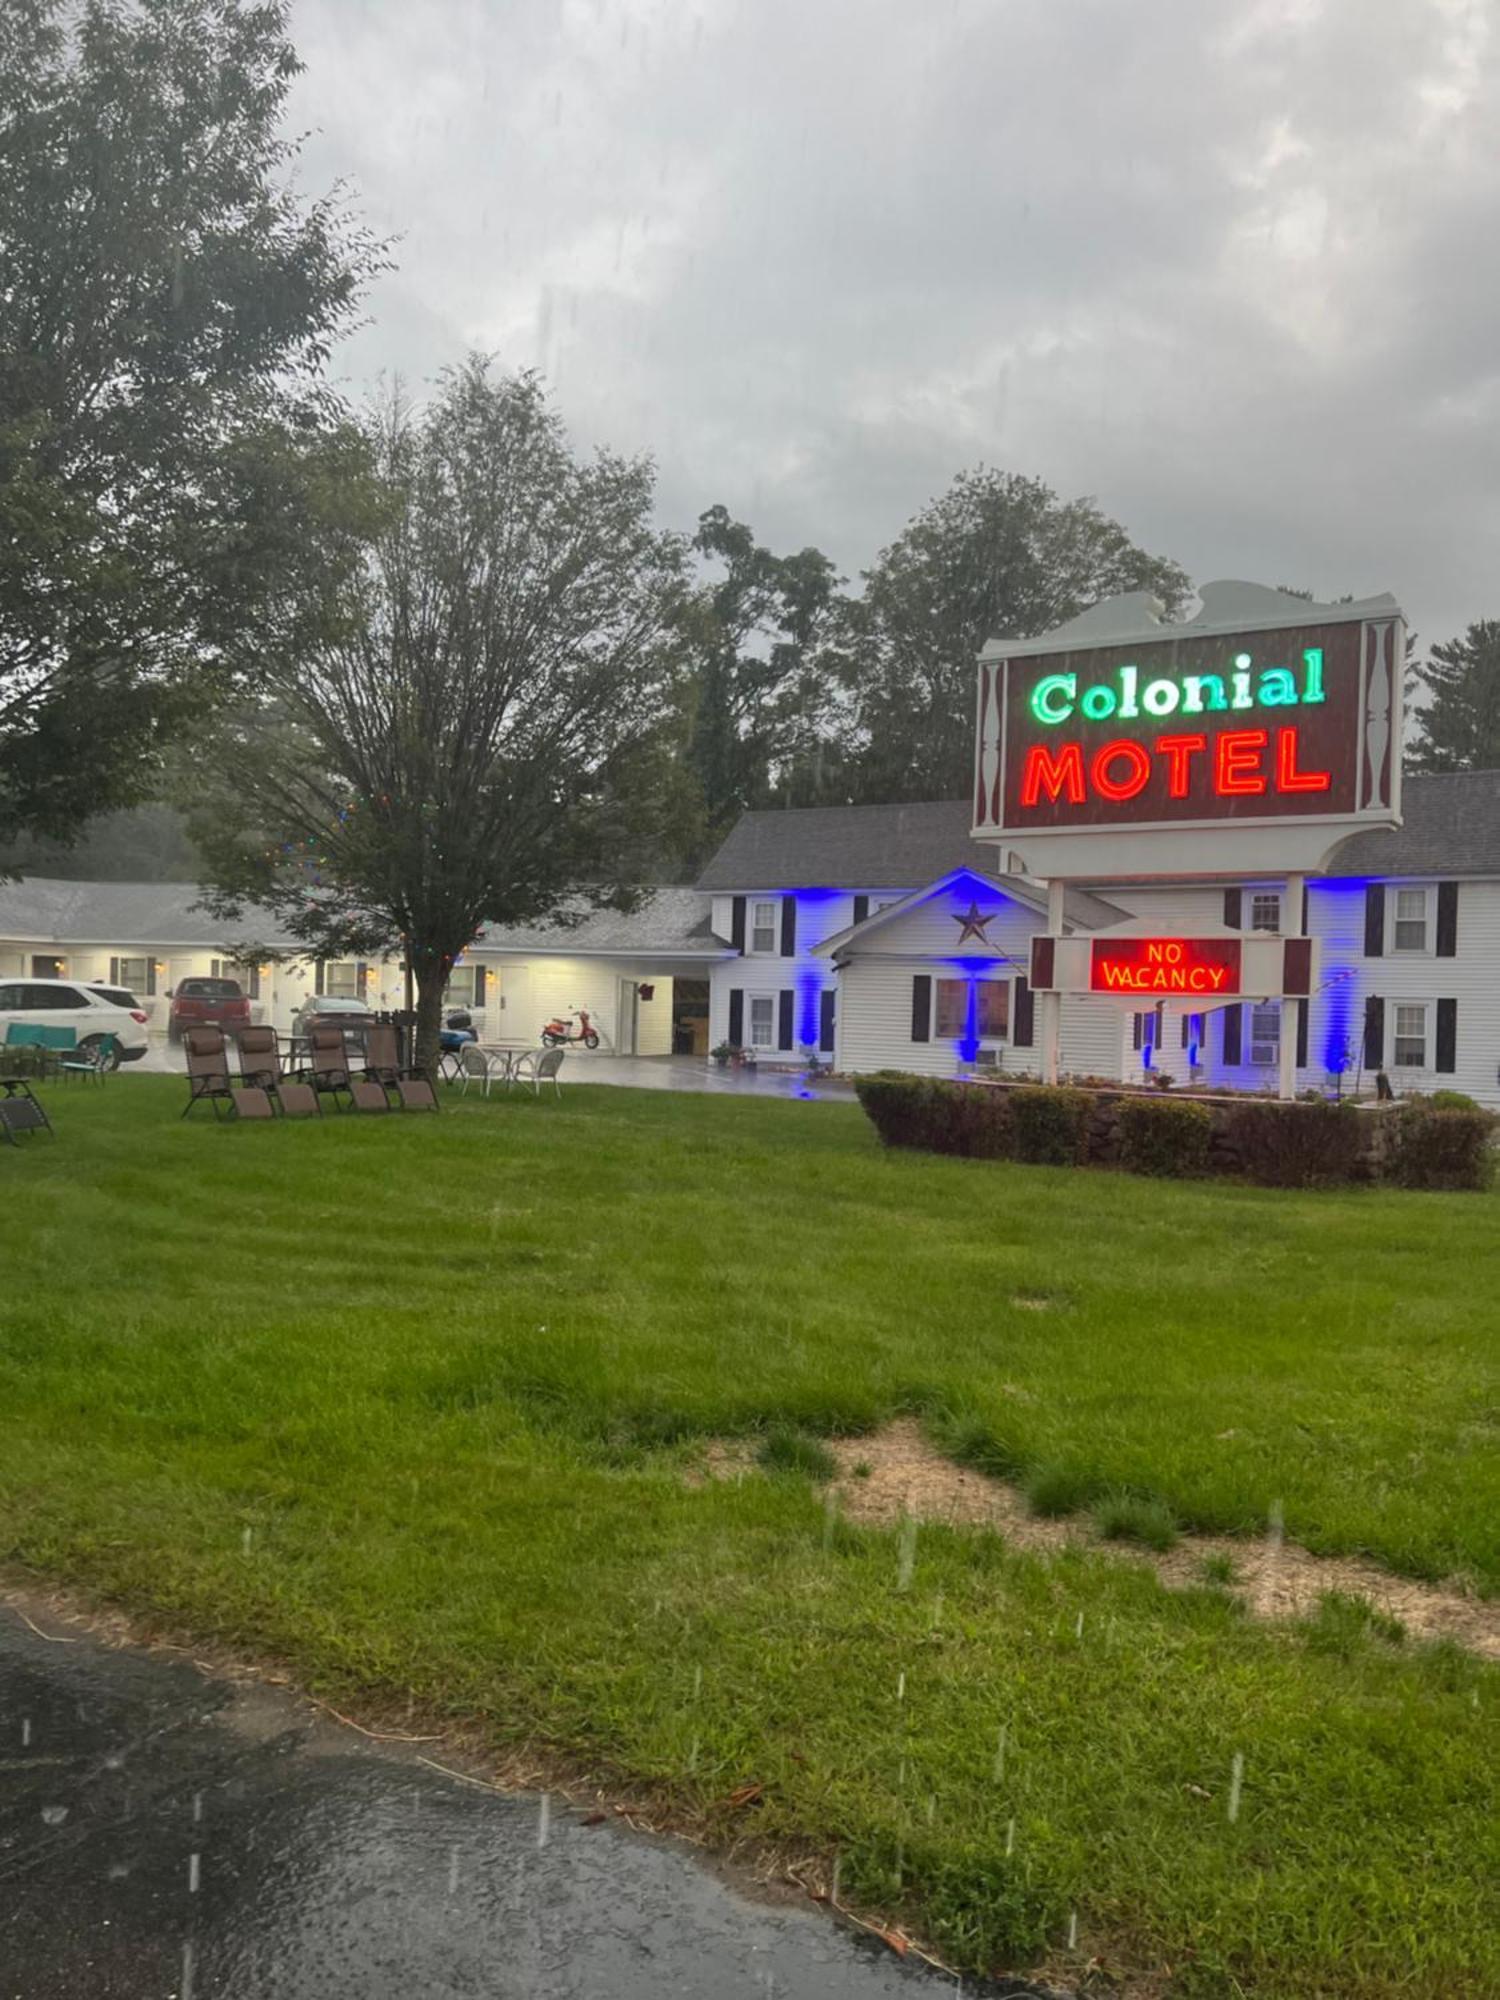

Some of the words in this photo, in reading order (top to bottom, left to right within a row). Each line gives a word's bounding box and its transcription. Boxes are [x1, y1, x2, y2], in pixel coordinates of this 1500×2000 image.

[1031, 648, 1326, 724] Colonial
[1021, 727, 1331, 807] MOTEL
[1148, 943, 1182, 964] NO
